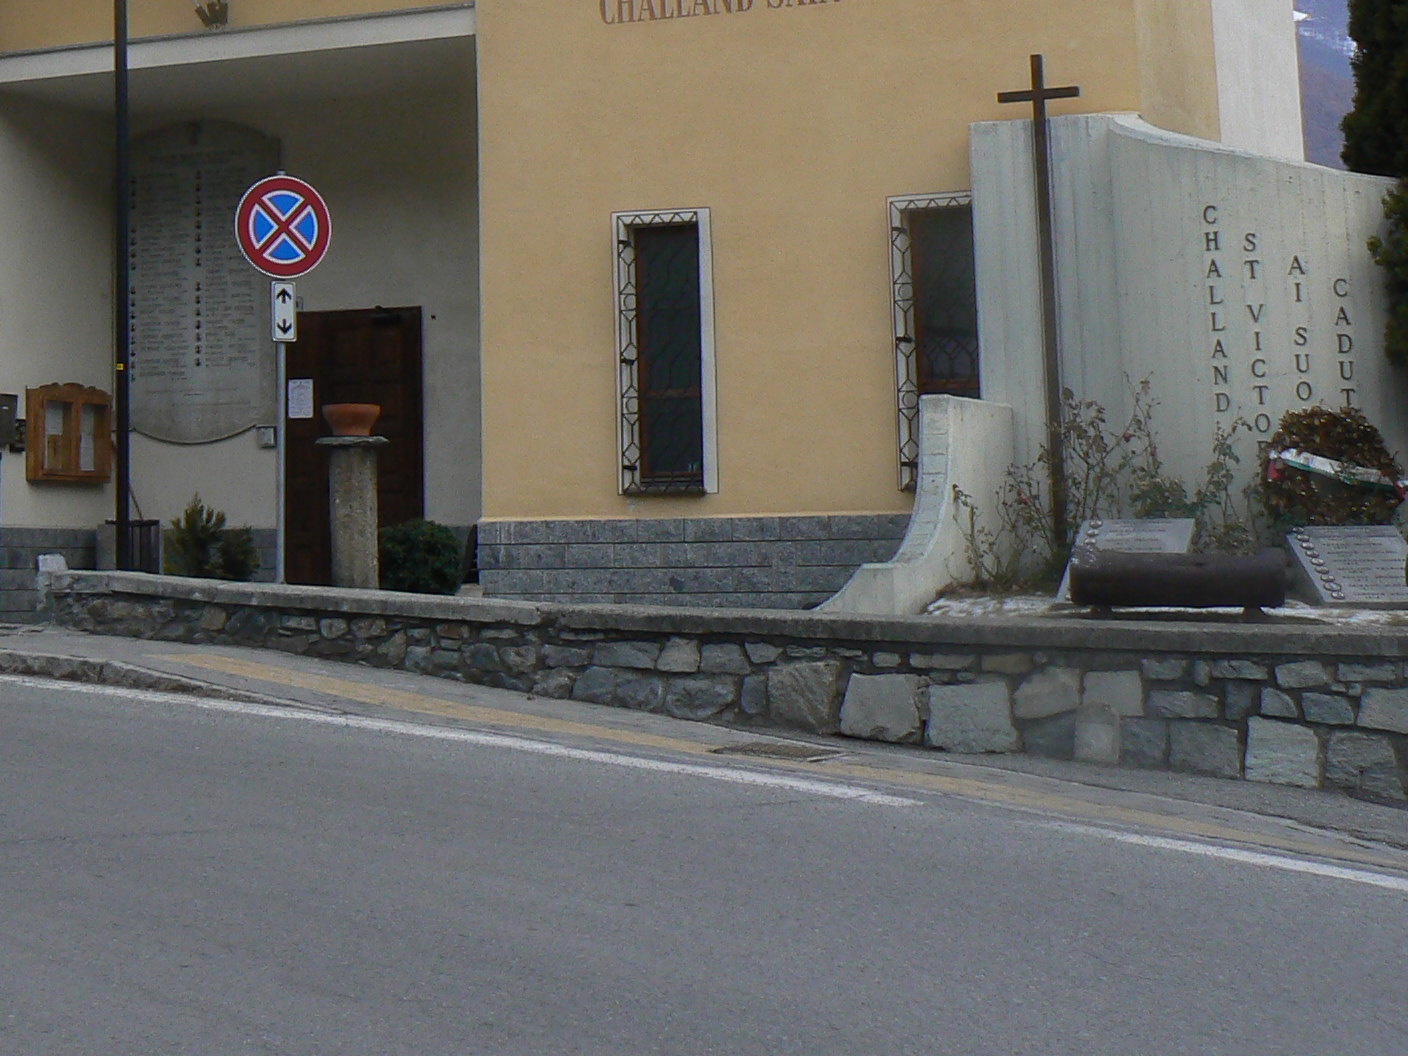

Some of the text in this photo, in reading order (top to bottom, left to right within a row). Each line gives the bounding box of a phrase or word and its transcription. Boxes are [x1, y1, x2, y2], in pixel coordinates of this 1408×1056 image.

[1203, 205, 1230, 413] CHALLAND
[1243, 232, 1260, 280] ST
[1288, 254, 1312, 401] AI SUO
